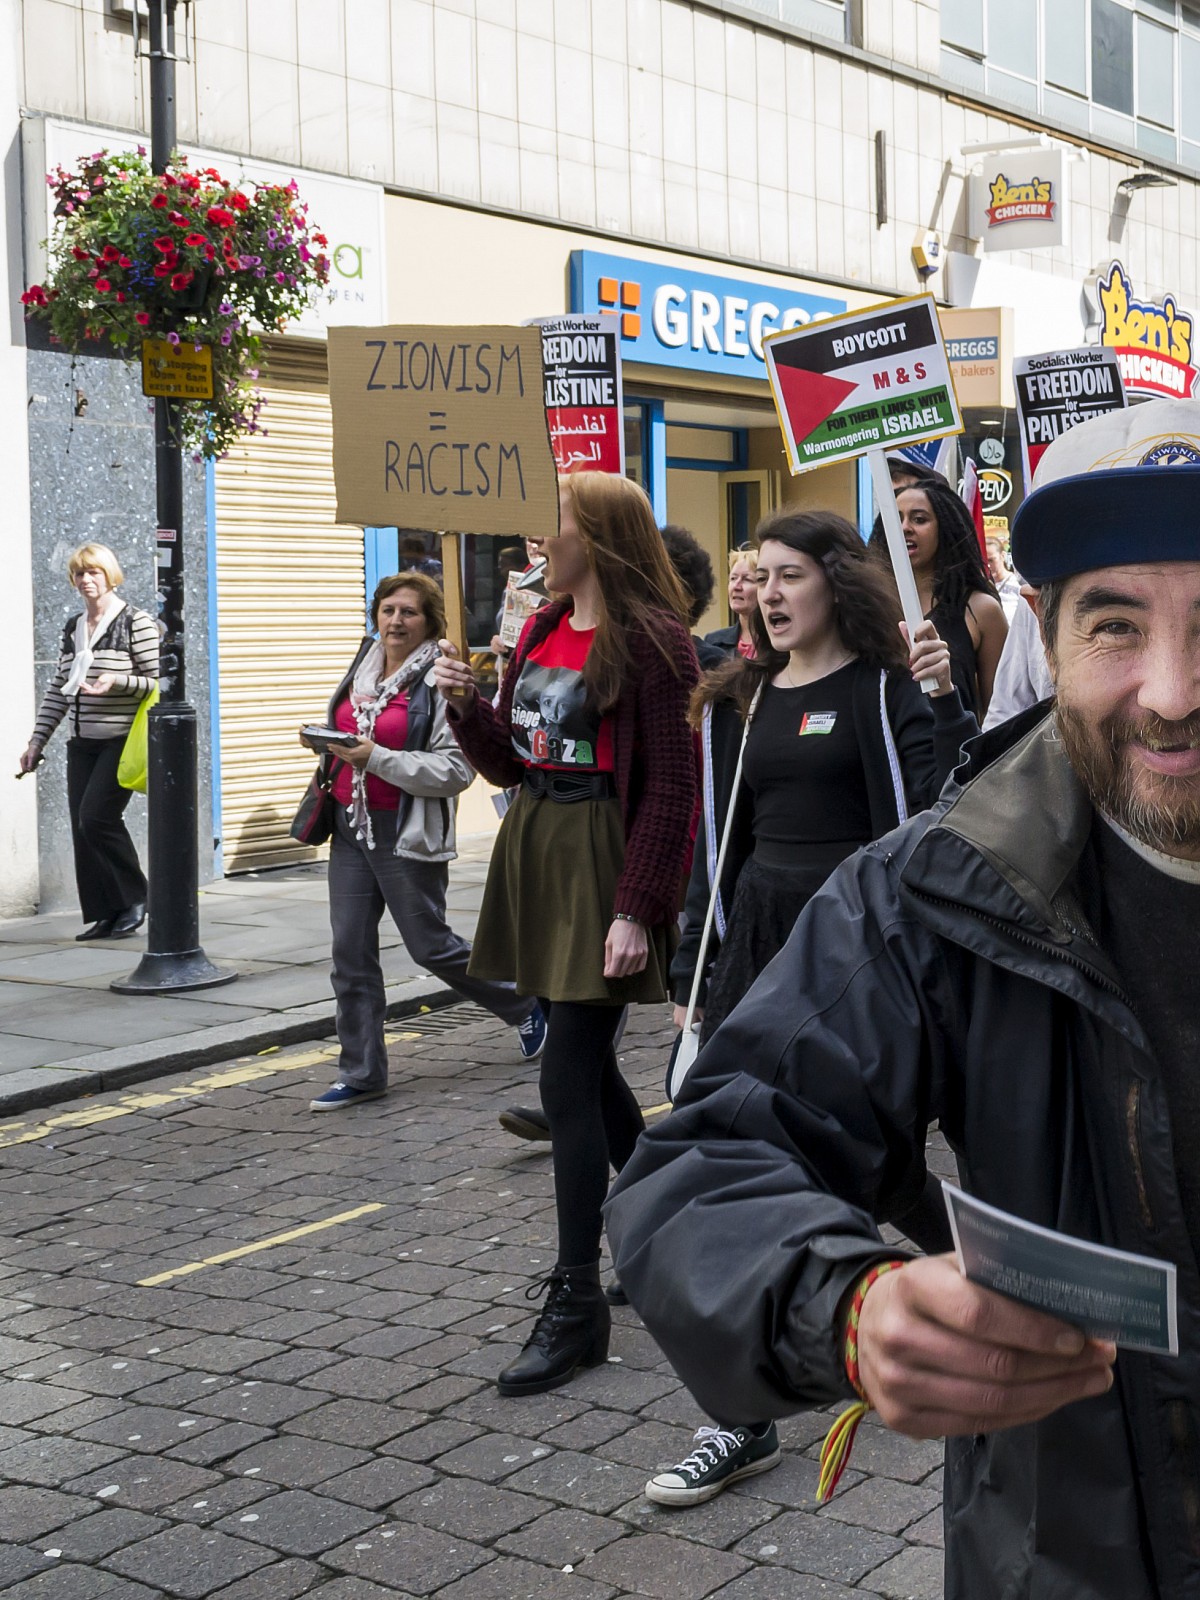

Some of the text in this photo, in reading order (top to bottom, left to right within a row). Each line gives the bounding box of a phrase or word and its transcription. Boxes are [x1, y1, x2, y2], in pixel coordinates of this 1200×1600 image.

[990, 174, 1051, 208] Ben's
[994, 204, 1048, 220] CHICKEN
[564, 319, 601, 332] Worker
[653, 283, 834, 363] GREG
[1101, 268, 1192, 364] Ben's
[543, 335, 607, 365] REEDOM
[831, 322, 907, 358] BOYCOTT
[365, 340, 524, 398] ZIONISM
[555, 365, 567, 378] for
[872, 362, 927, 390] M & S
[960, 364, 996, 377] bakers
[1027, 352, 1103, 371] Socialist Worker
[546, 378, 615, 407] LESTINE
[1025, 366, 1114, 402] FREEDOM
[826, 390, 947, 432] FOR THEIR LINKS WITH
[1065, 399, 1078, 412] for
[803, 427, 880, 456] Warmongering
[882, 406, 944, 436] ISRAEL
[1149, 446, 1197, 462] KIWANIS
[385, 440, 526, 501] RACISM
[511, 707, 541, 729] siege
[532, 729, 594, 764] Gaza
